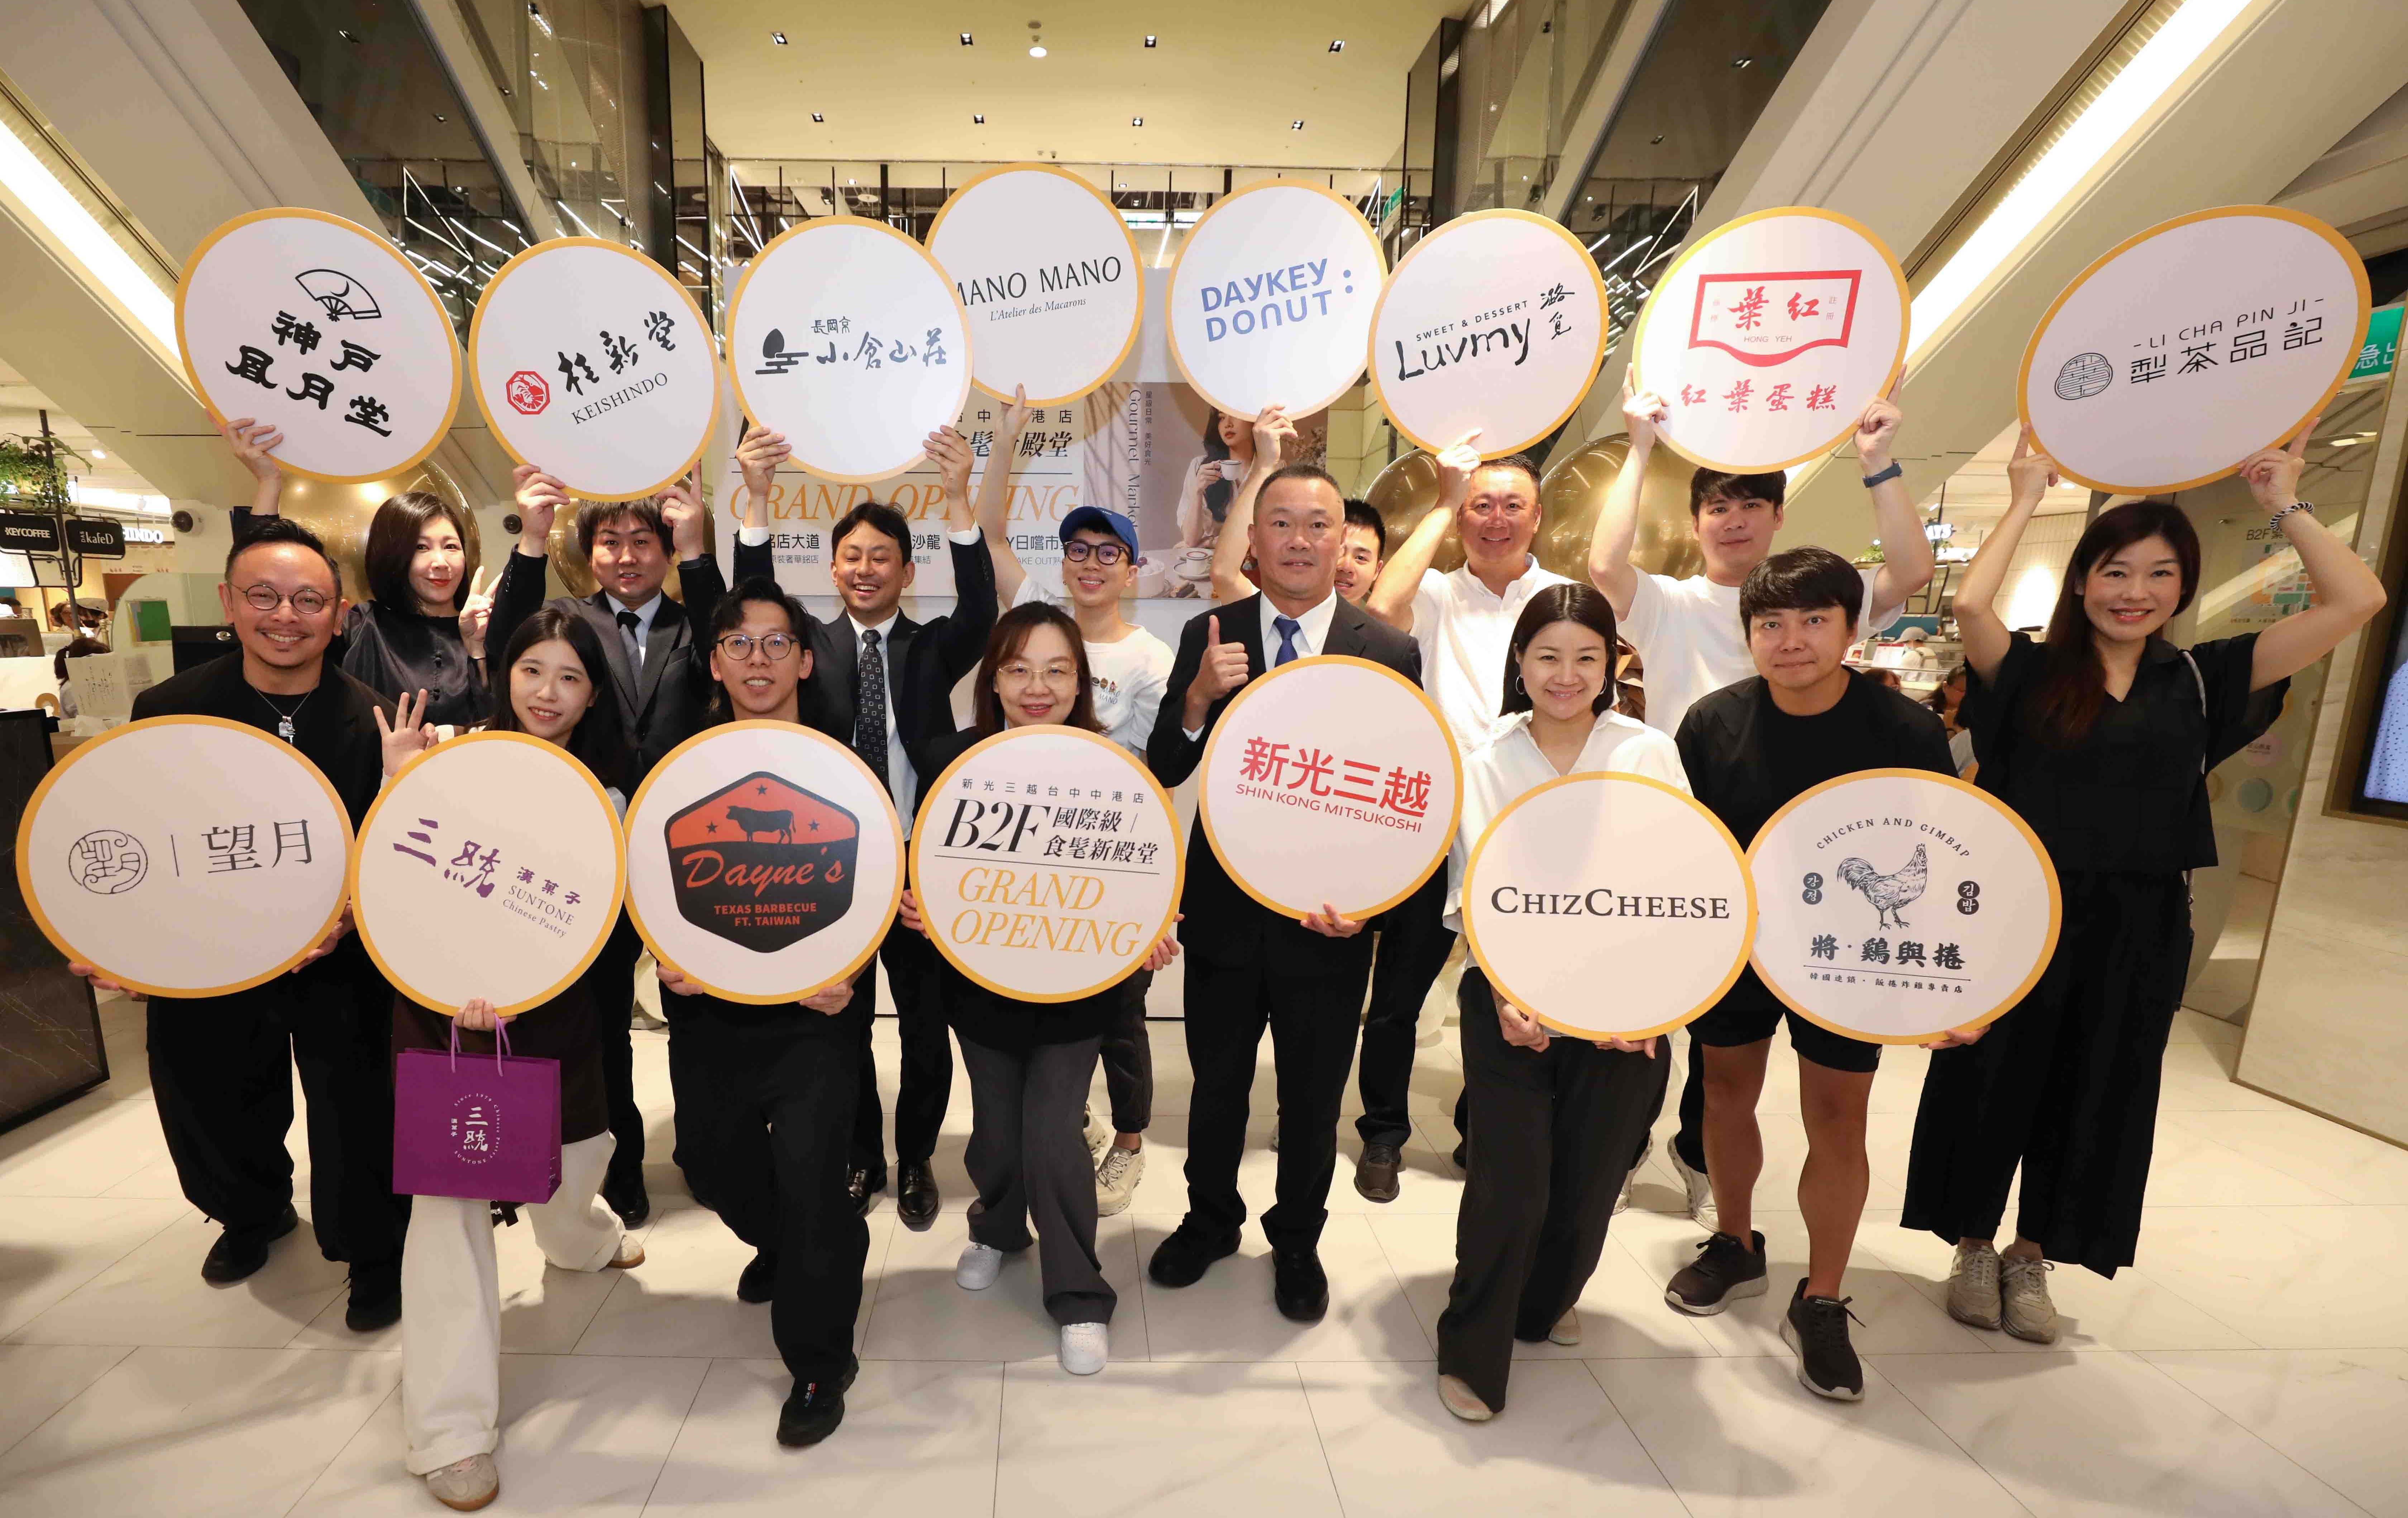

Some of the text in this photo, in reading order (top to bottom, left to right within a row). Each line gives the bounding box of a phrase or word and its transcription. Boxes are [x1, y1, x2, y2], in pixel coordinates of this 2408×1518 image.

[1039, 256, 1121, 293] MANO
[990, 297, 1086, 321] L'Atelier des Macarons
[1416, 323, 1454, 342] SWEET
[1475, 300, 1528, 323] DESSERT
[2179, 320, 2222, 341] CHA
[2237, 307, 2274, 327] PIN
[1395, 318, 1530, 381] Luvmy
[570, 372, 668, 425] KEISHINDO
[1681, 379, 1837, 413] 紅葉蛋糕
[1128, 389, 1142, 462] Gourmet
[962, 777, 1145, 803] 新光三越台中中港店
[1239, 736, 1432, 818] 新光三越
[938, 798, 1051, 853] B2F
[1052, 806, 1123, 833] 國際級
[1235, 784, 1422, 833] SHIN KONG MITSUKOSHI
[201, 818, 313, 874] 望月
[1043, 834, 1158, 865] 食髦新殿堂
[1816, 817, 1970, 857] CHICKEN AND GIMBAP
[516, 866, 581, 905] 漢菓子
[682, 846, 846, 897] Dayne's
[958, 867, 1104, 910] GRAND
[502, 898, 567, 938] Chinese Pastry
[508, 885, 574, 926] SUNTONE
[713, 903, 817, 915] TEXAS BARBECUE
[1961, 882, 1978, 914] 김밥
[735, 915, 800, 927] FT. TAIWAN
[951, 909, 1143, 956] OPENING
